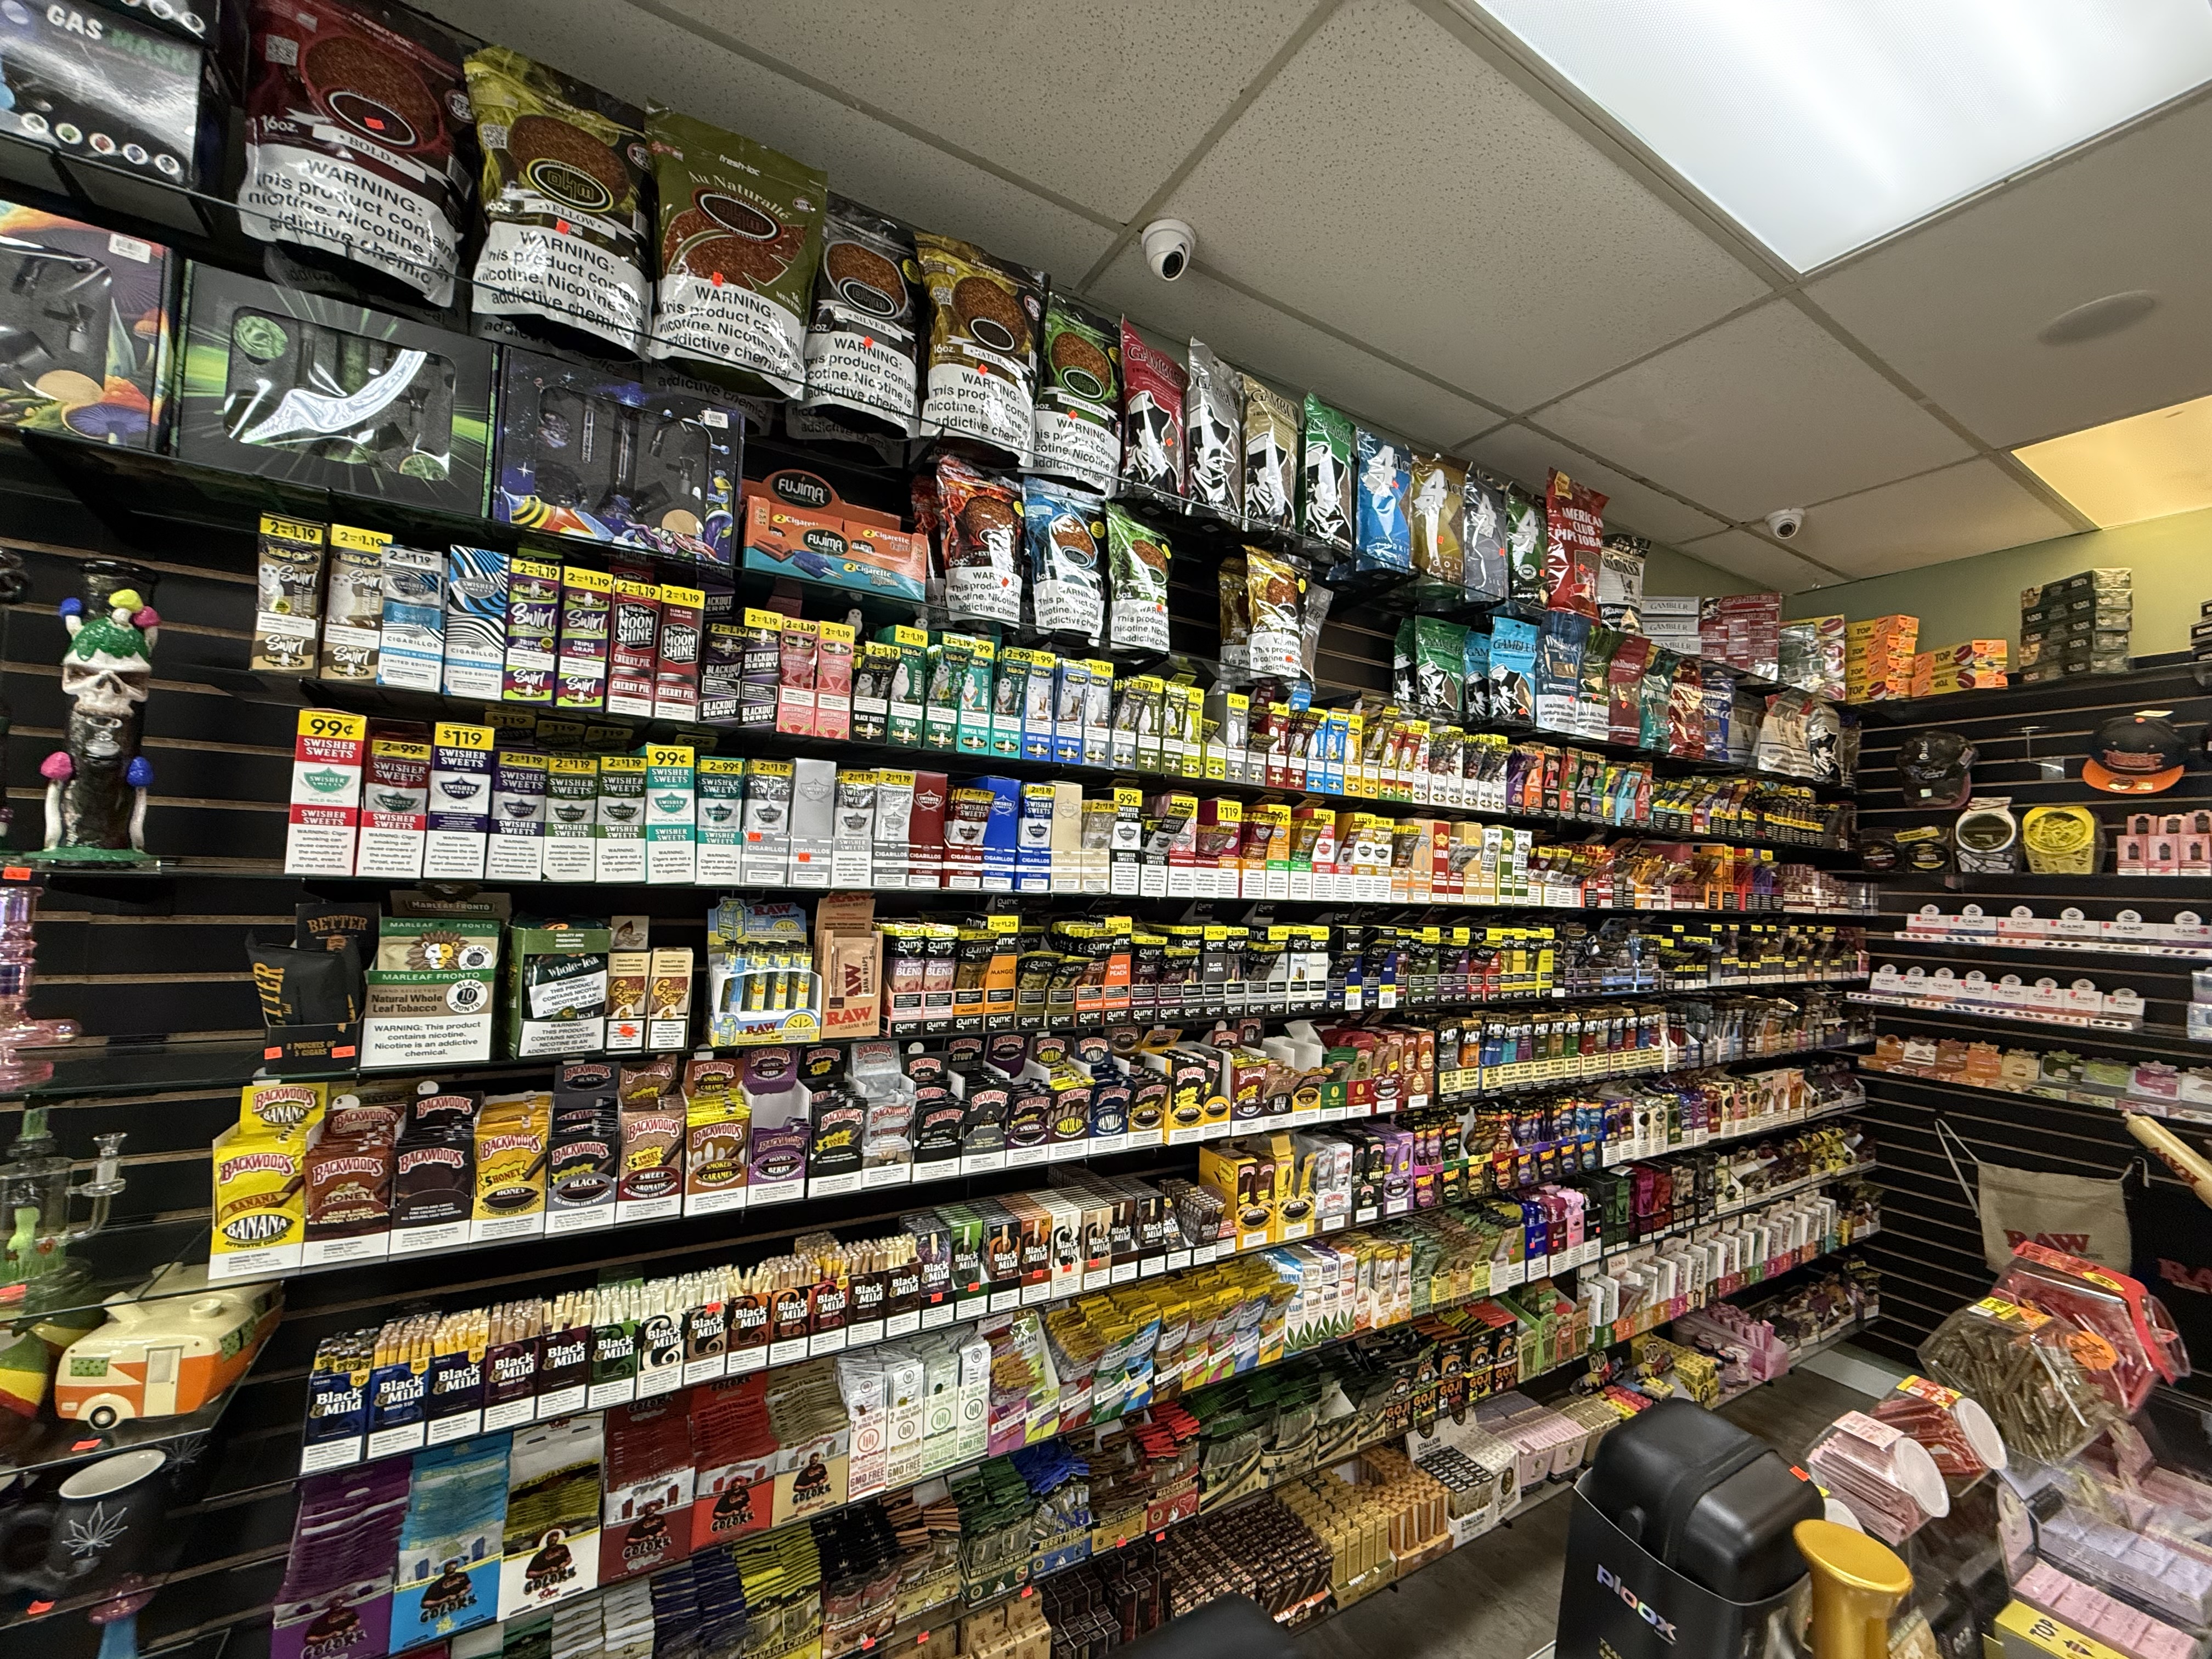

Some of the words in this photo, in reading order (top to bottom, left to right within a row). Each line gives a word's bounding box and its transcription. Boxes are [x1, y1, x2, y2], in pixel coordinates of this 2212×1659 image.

[46, 3, 104, 40] GAS
[260, 115, 299, 134] 16oz.
[348, 133, 392, 163] BOLD
[689, 171, 710, 185] Au
[306, 158, 424, 218] WARNING:
[297, 180, 385, 219] product
[545, 202, 595, 226] YELLOW
[696, 285, 777, 318] WARNING:
[690, 305, 749, 329] product
[853, 313, 887, 332] SILVER
[665, 335, 730, 355] addictive
[718, 323, 776, 356] Nicotine
[934, 343, 957, 355] 16oz.
[828, 355, 881, 376] product
[854, 372, 902, 400] Nicotine
[1061, 394, 1086, 409] MENTHOL
[1086, 404, 1104, 417] GOLD
[935, 415, 989, 431] addictive
[778, 478, 825, 504] FUJIMA
[1573, 520, 1595, 536] CLUB
[808, 533, 844, 552] FUJIMA
[1555, 529, 1577, 544] PIPE
[280, 565, 318, 587] Swirl
[855, 565, 891, 578] Cigarette
[511, 602, 555, 630] Swirl
[567, 609, 605, 633] Swirl
[619, 616, 653, 628] MOON
[617, 628, 653, 641] SHINE
[265, 635, 305, 654] Swirl
[387, 637, 438, 648] CIGARILLOS
[383, 659, 409, 667] LIMITED
[745, 652, 778, 663] BLACKOUT
[1934, 651, 1950, 662] TOP
[745, 660, 778, 669] BERRY
[612, 680, 635, 692] CHERRY
[637, 682, 650, 693] PIE
[658, 687, 680, 698] CHERRY
[681, 689, 694, 698] PIE
[1848, 685, 1864, 695] TOP
[311, 719, 353, 736] 99¢
[896, 718, 916, 727] EMERALD
[303, 738, 356, 750] SWISHER
[306, 747, 353, 758] SWEETS
[439, 749, 487, 760] SWISHER
[655, 751, 686, 765] 99¢
[374, 762, 426, 774] SWISHER
[442, 757, 484, 768] SWEETS
[376, 770, 422, 782] SWEETS
[550, 778, 594, 787] SWISHER
[653, 775, 688, 783] SWEETS
[552, 786, 592, 794] SWEETS
[748, 845, 787, 853] CIGARILLOS
[456, 902, 490, 910] FRONTO
[753, 904, 792, 917] RAW
[307, 916, 368, 933] BETTER
[467, 946, 490, 954] BLACK
[382, 972, 433, 980] MARLEAF
[895, 967, 922, 976] BLEND
[456, 981, 482, 990] BLACK
[371, 995, 408, 1003] Natural
[410, 994, 443, 1002] Whole
[460, 990, 475, 1000] 10
[373, 1004, 395, 1013] Leaf
[397, 1004, 437, 1012] Tobacco
[450, 1001, 481, 1013] FRONTO
[826, 1007, 872, 1026] RAW
[1079, 1011, 1101, 1025] game
[374, 1024, 423, 1032] WARNING:
[446, 1022, 481, 1030] product
[895, 1022, 917, 1034] game
[387, 1032, 426, 1041] contains
[375, 1041, 413, 1049] Nicotine
[438, 1039, 478, 1047] addictive
[527, 1046, 562, 1054] ADDICTIVE
[405, 1049, 448, 1058] chemical.
[952, 1052, 974, 1061] STOUT
[253, 1087, 317, 1111] BACKWOODS
[263, 1107, 305, 1123] BANANA
[693, 1123, 743, 1148] BACKWOODS
[552, 1142, 609, 1165] BACKWOODS
[399, 1148, 464, 1174] BACKWOODS
[219, 1153, 295, 1185] BACKWOODS
[313, 1157, 383, 1186] BACKWOODS
[492, 1166, 522, 1183] HONEY
[702, 1171, 733, 1181] CARAMEL
[569, 1178, 598, 1188] BLACK
[635, 1182, 668, 1192] AROMATIC
[323, 1191, 372, 1203] HONEY
[226, 1215, 287, 1240] BANANA
[923, 1262, 950, 1273] Black
[892, 1275, 919, 1286] Black
[928, 1271, 950, 1281] Mild
[896, 1283, 919, 1295] Mild
[1323, 1291, 1339, 1301] KARMA
[495, 1353, 534, 1370] Black
[500, 1363, 534, 1379] Mild
[1469, 1373, 1492, 1389] GOJI
[317, 1388, 363, 1404] Black
[325, 1399, 362, 1416] Mild
[889, 1413, 895, 1424] 2
[1417, 1436, 1442, 1452] STALLION
[887, 1466, 904, 1478] GMO
[905, 1460, 921, 1471] FREE
[2028, 1618, 2059, 1641] TOP
